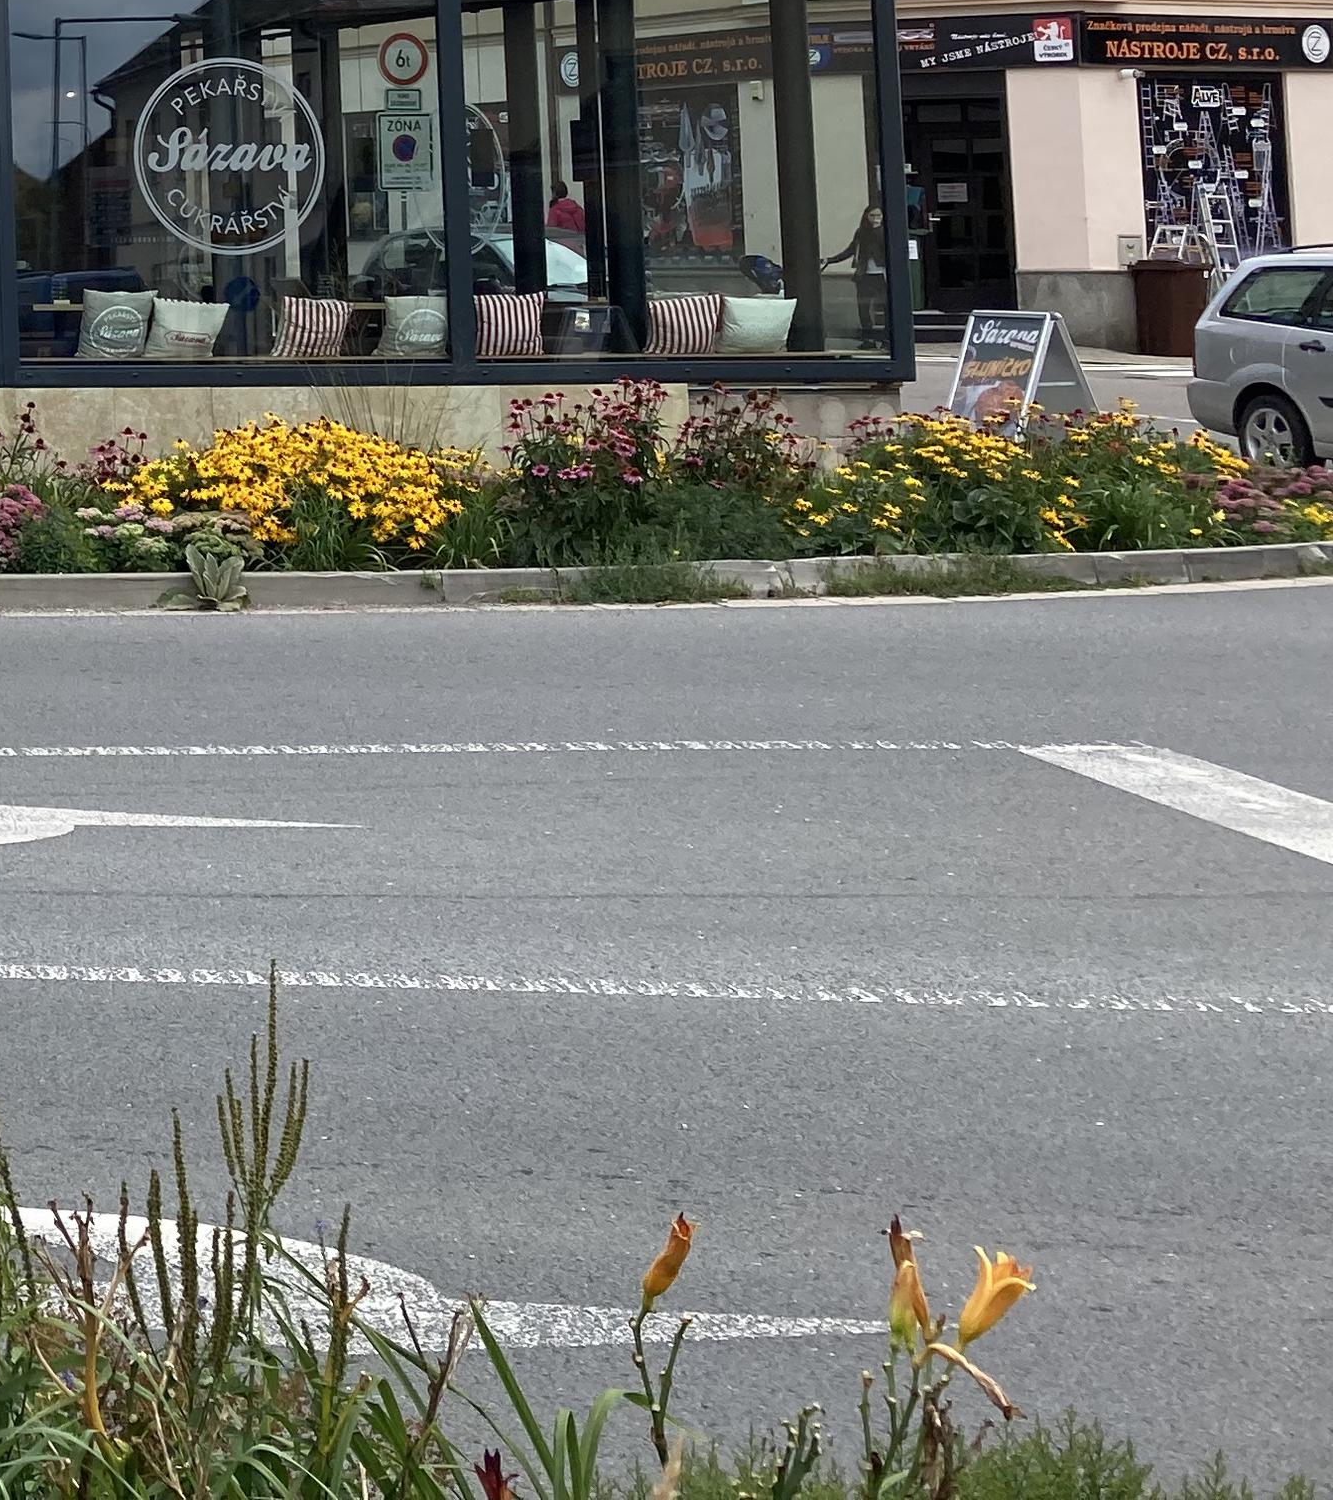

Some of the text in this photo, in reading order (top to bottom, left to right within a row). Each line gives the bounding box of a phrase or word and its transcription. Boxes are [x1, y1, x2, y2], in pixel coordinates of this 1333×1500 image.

[1087, 20, 1133, 31] Značková
[1135, 22, 1176, 35] prodejna
[1214, 23, 1253, 37] nástrojů
[1254, 26, 1261, 34] a
[1262, 25, 1296, 35] brusiva
[395, 49, 411, 68] 6t
[919, 56, 937, 68] MY
[941, 48, 972, 63] JSME
[1105, 38, 1280, 62] NÁSTROJE CZ, s.r.o.
[722, 57, 763, 72] s.r.o.
[170, 73, 297, 123] PEKAŘSTVÍ
[387, 117, 422, 133] ZÓNA
[147, 125, 313, 172] Sázava
[972, 319, 1040, 344] Sázava
